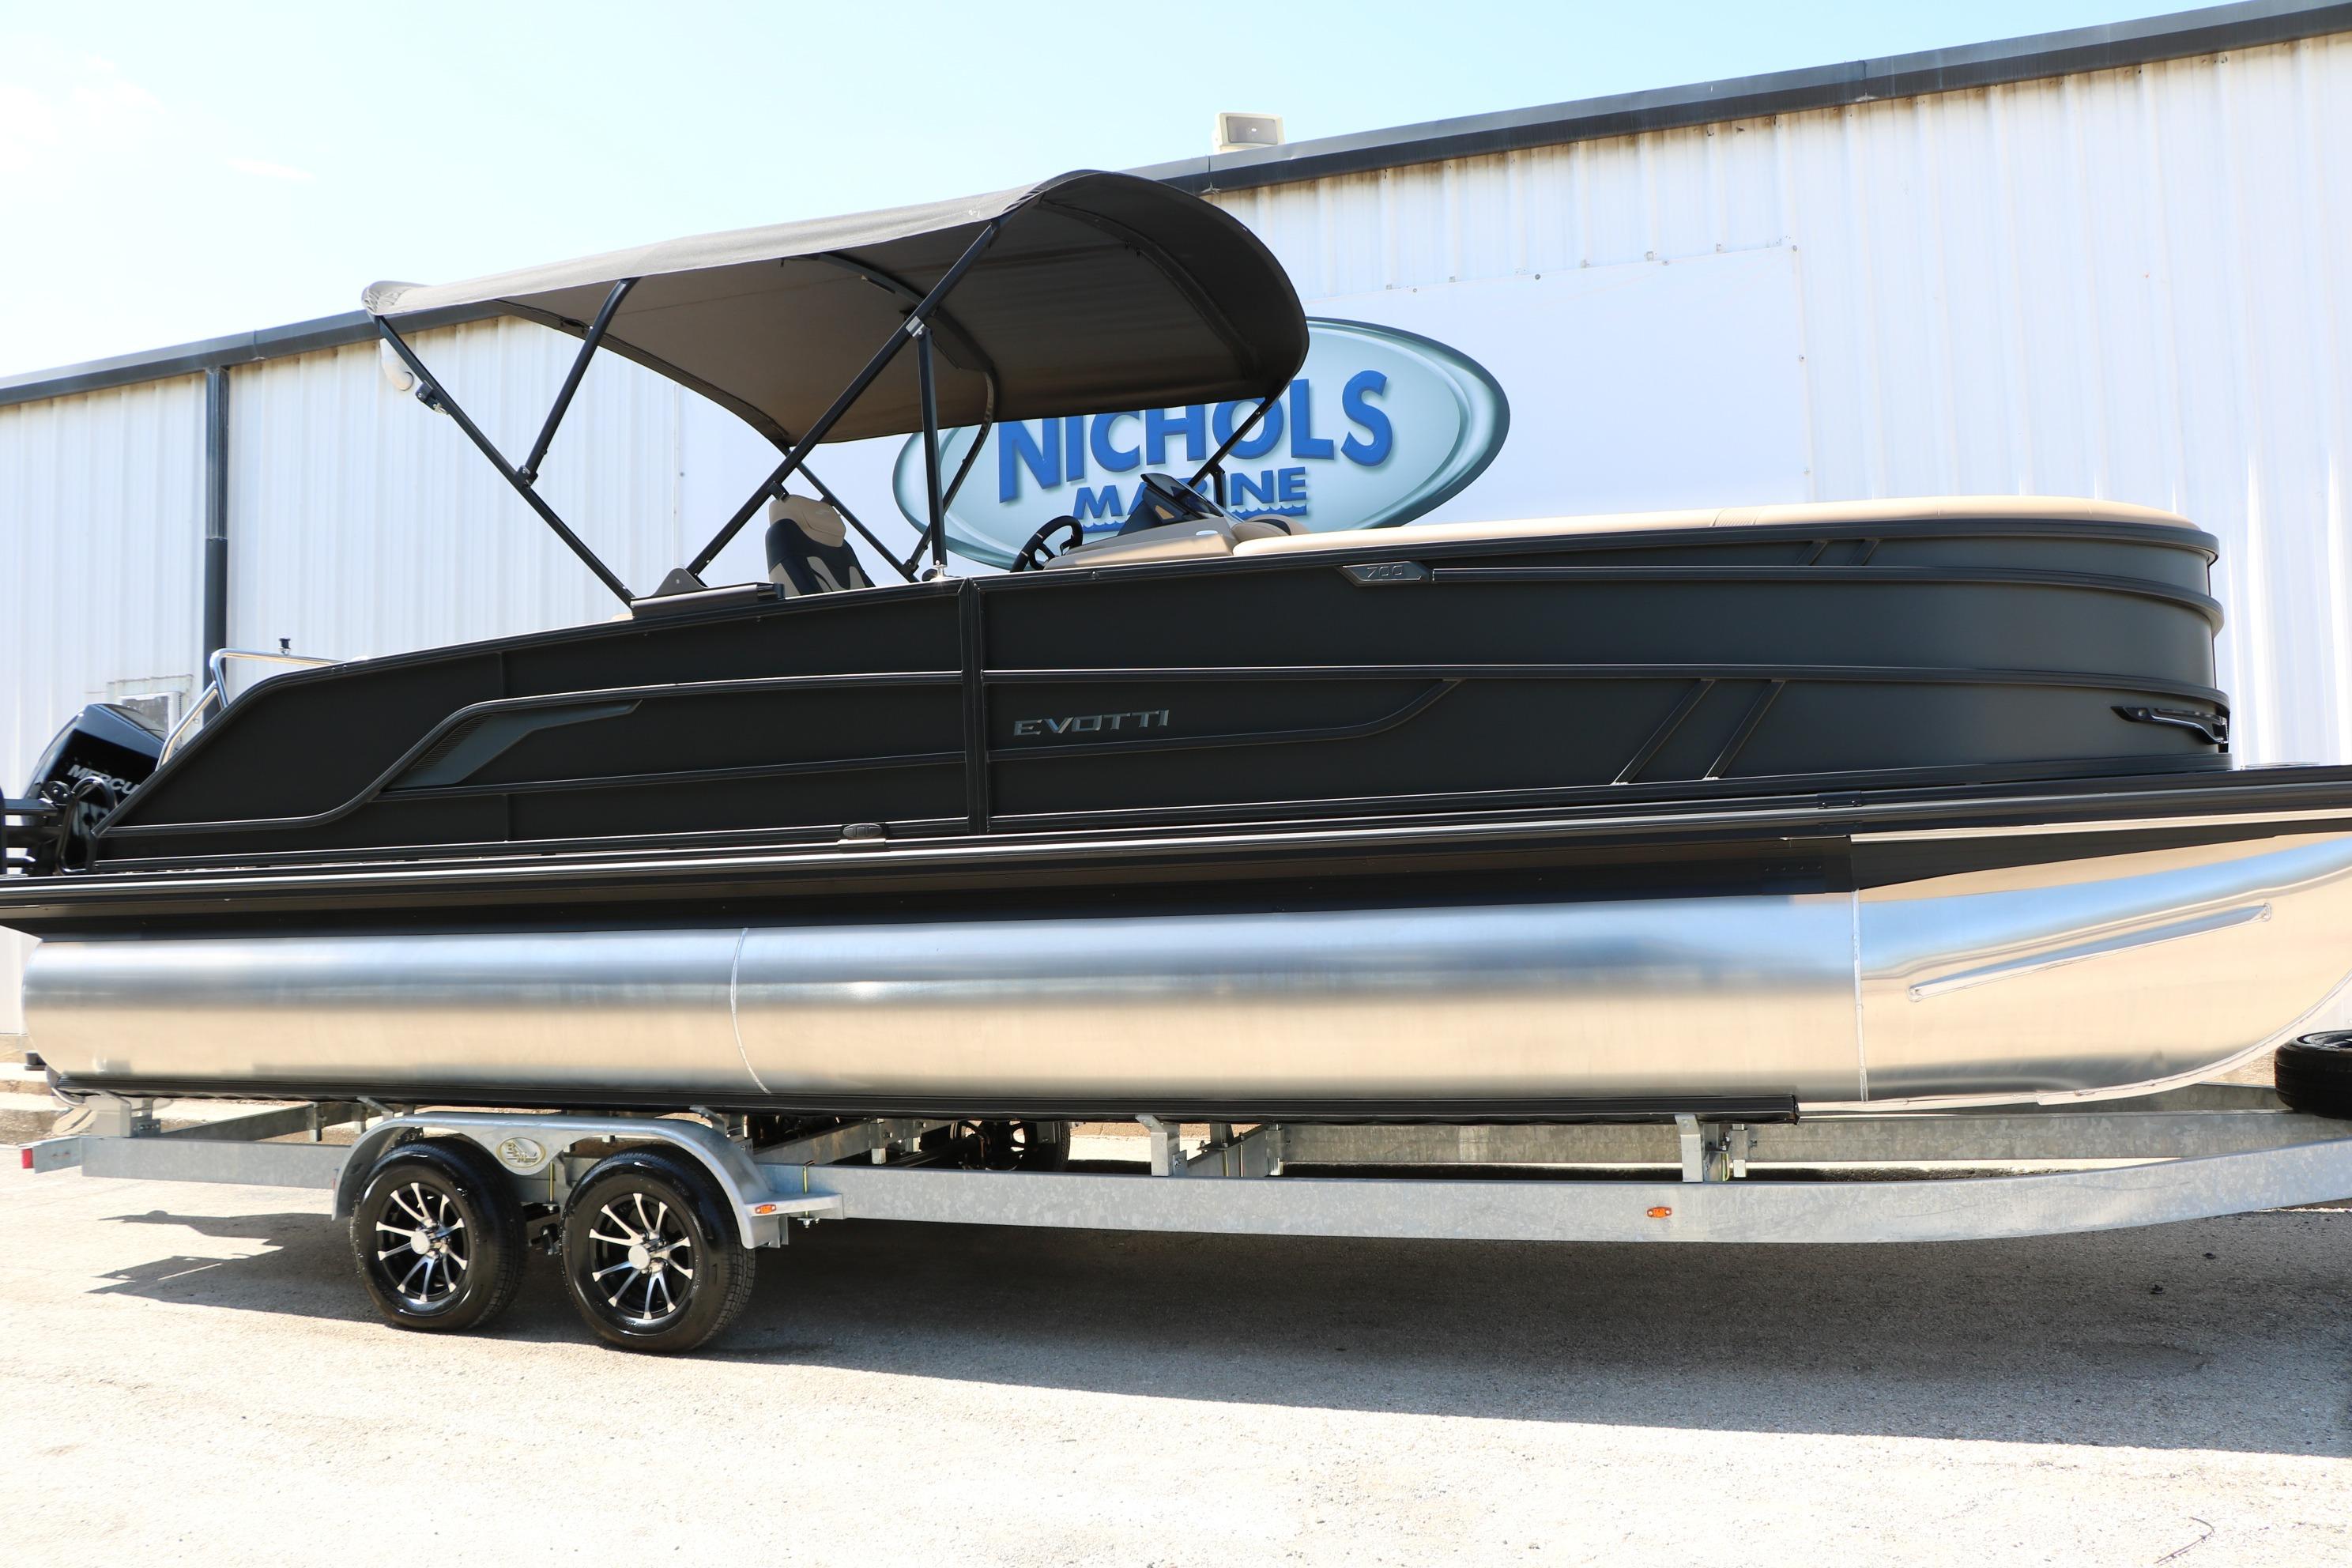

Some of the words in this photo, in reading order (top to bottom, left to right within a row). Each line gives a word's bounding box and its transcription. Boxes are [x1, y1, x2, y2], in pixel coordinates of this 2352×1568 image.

[998, 369, 1393, 504] NICHOLS
[1072, 466, 1307, 519] MNE
[1366, 564, 1404, 579] 700
[1013, 709, 1170, 737] EVOTTI
